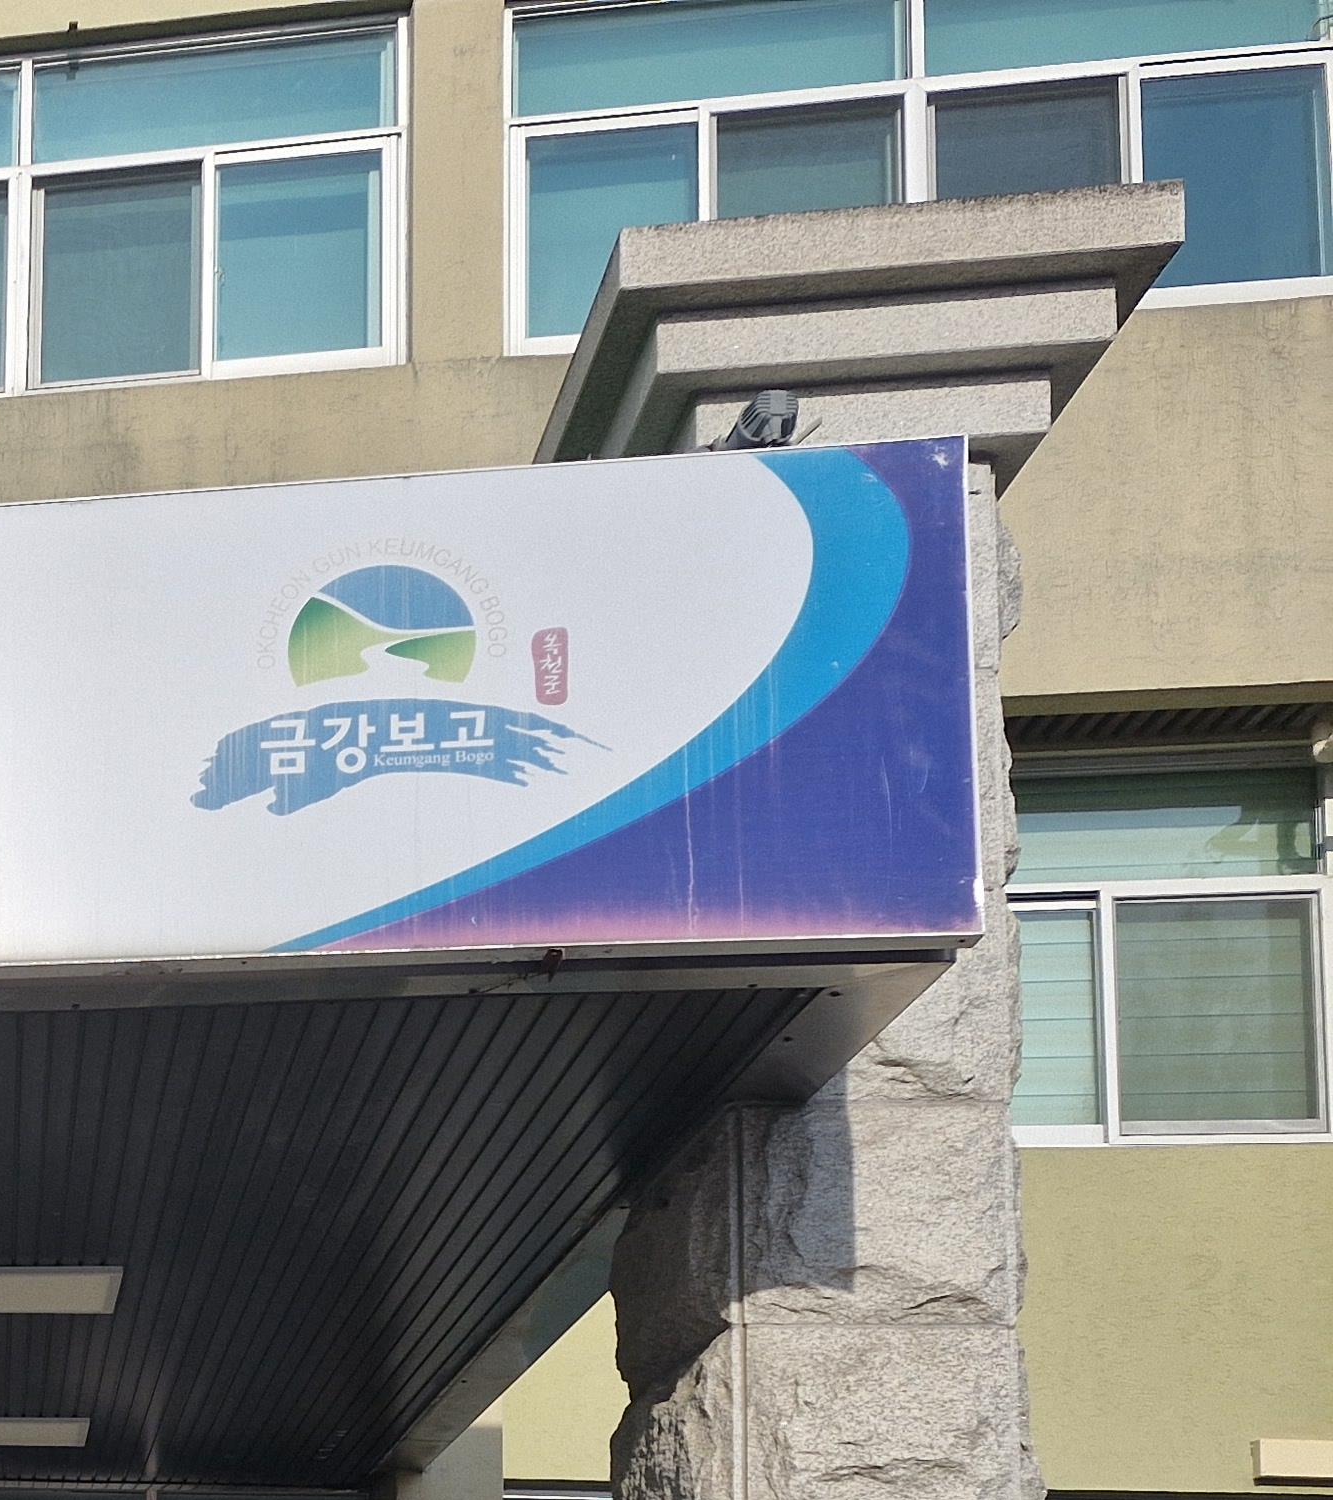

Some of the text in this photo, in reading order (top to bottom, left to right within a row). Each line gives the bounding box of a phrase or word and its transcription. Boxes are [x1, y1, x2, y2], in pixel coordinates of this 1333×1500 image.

[256, 537, 509, 670] OKCHEON GUN KEUMGANG BOGO
[540, 632, 562, 696] 옥천군
[260, 710, 495, 776] 금강보고
[374, 749, 495, 768] Keumgang Bogo
